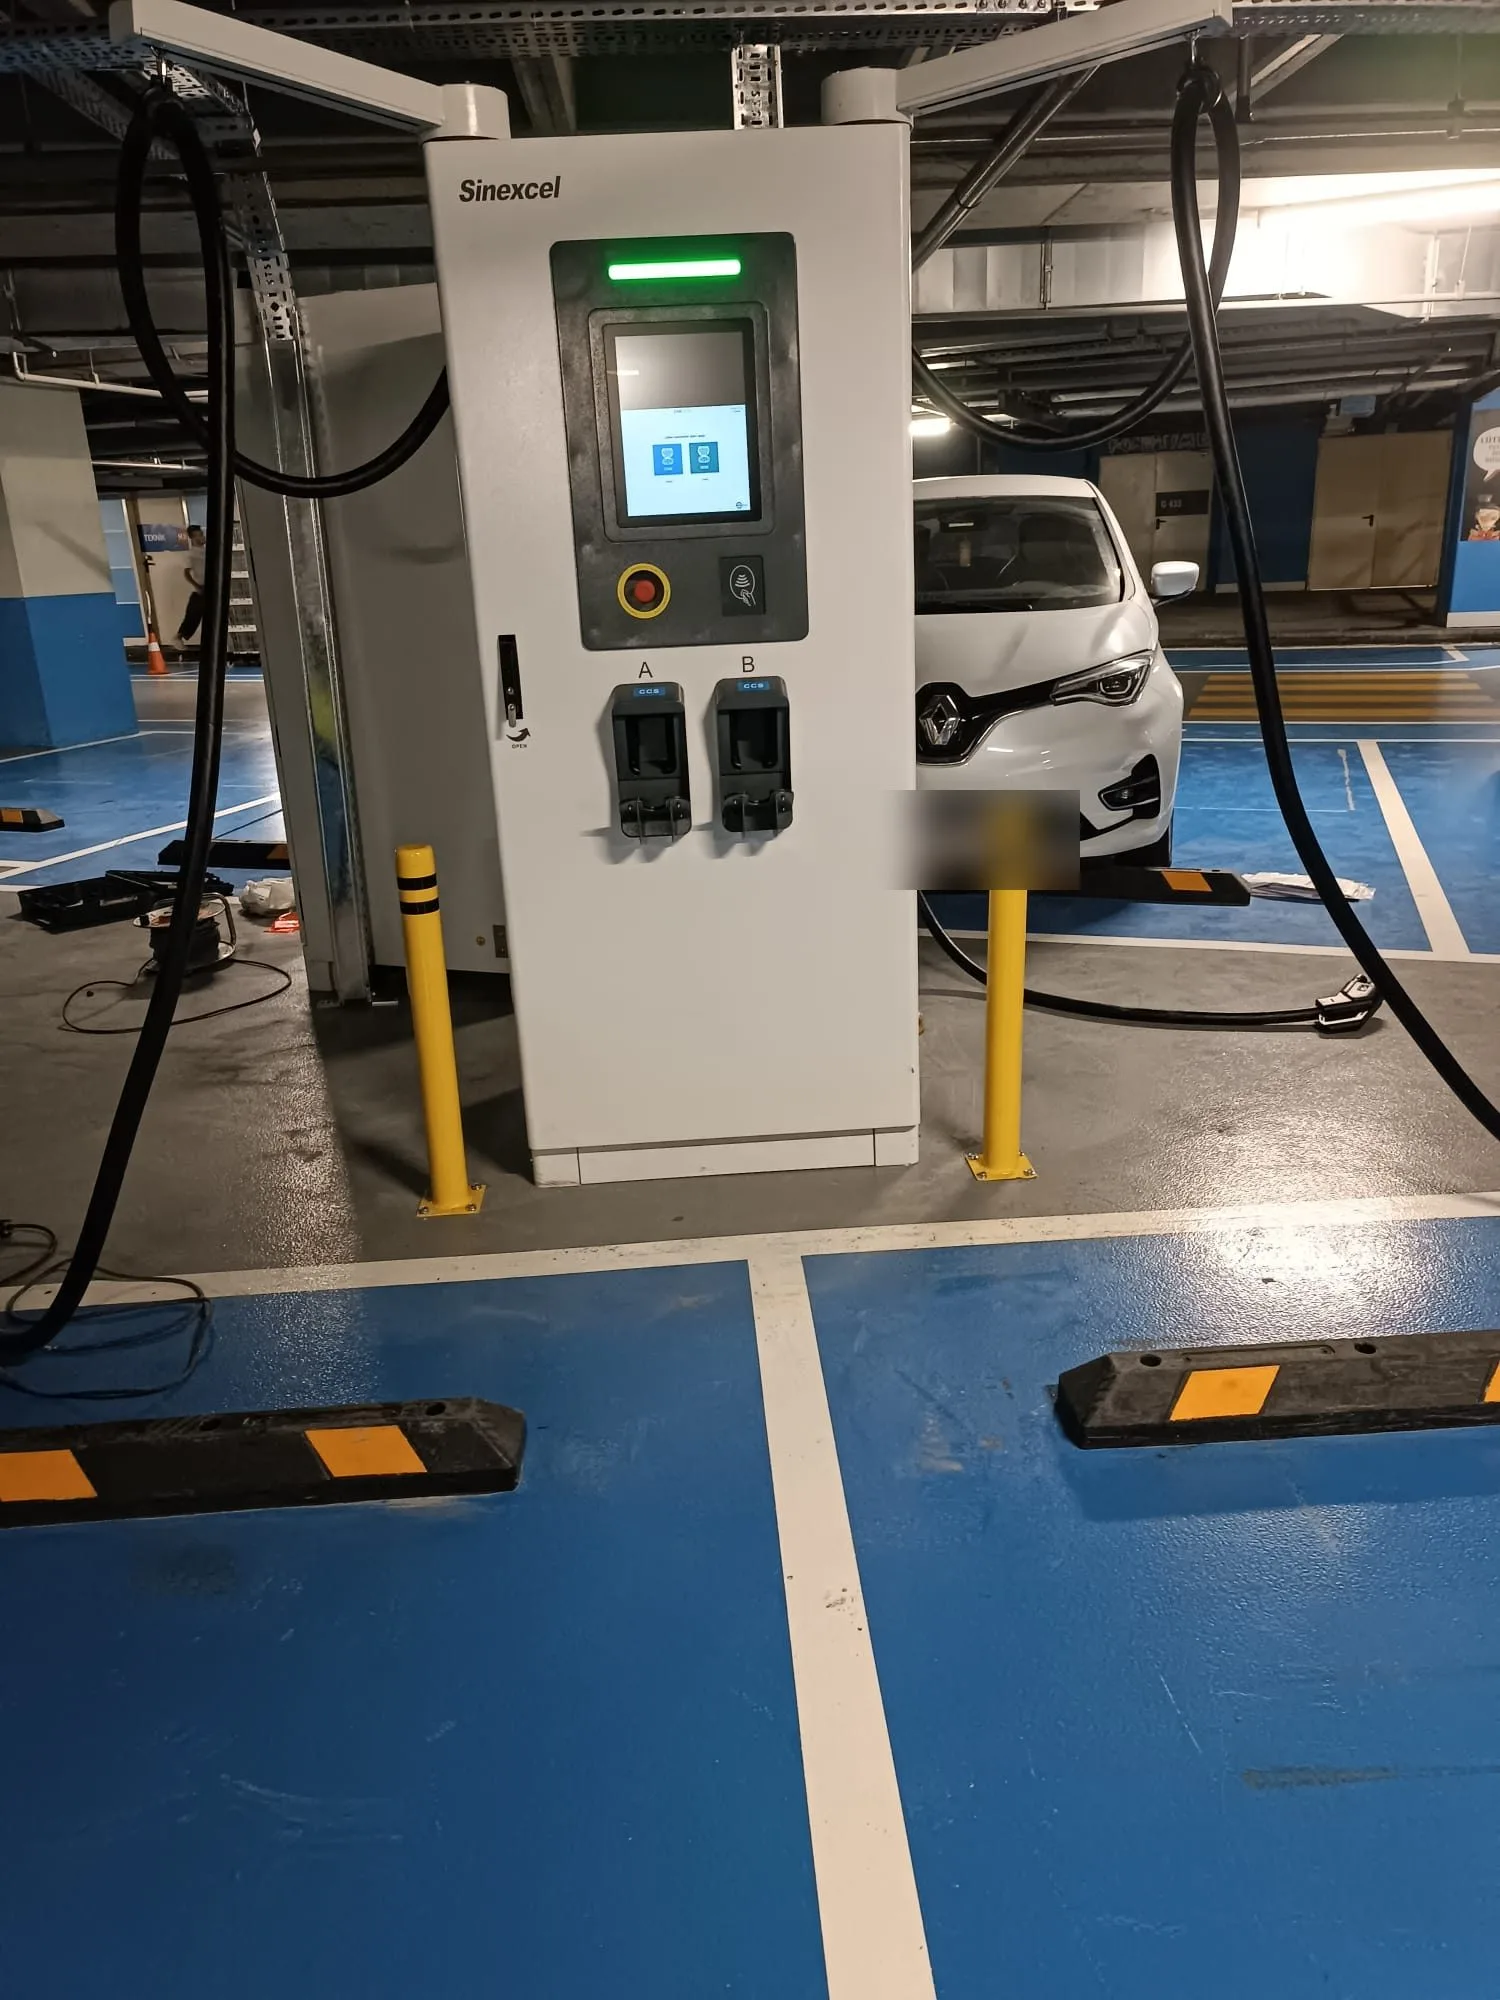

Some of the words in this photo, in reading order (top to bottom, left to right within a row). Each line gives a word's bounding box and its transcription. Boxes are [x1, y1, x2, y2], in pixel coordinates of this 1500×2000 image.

[459, 175, 561, 202] Sinexcel
[638, 661, 653, 679] A
[742, 656, 755, 673] B
